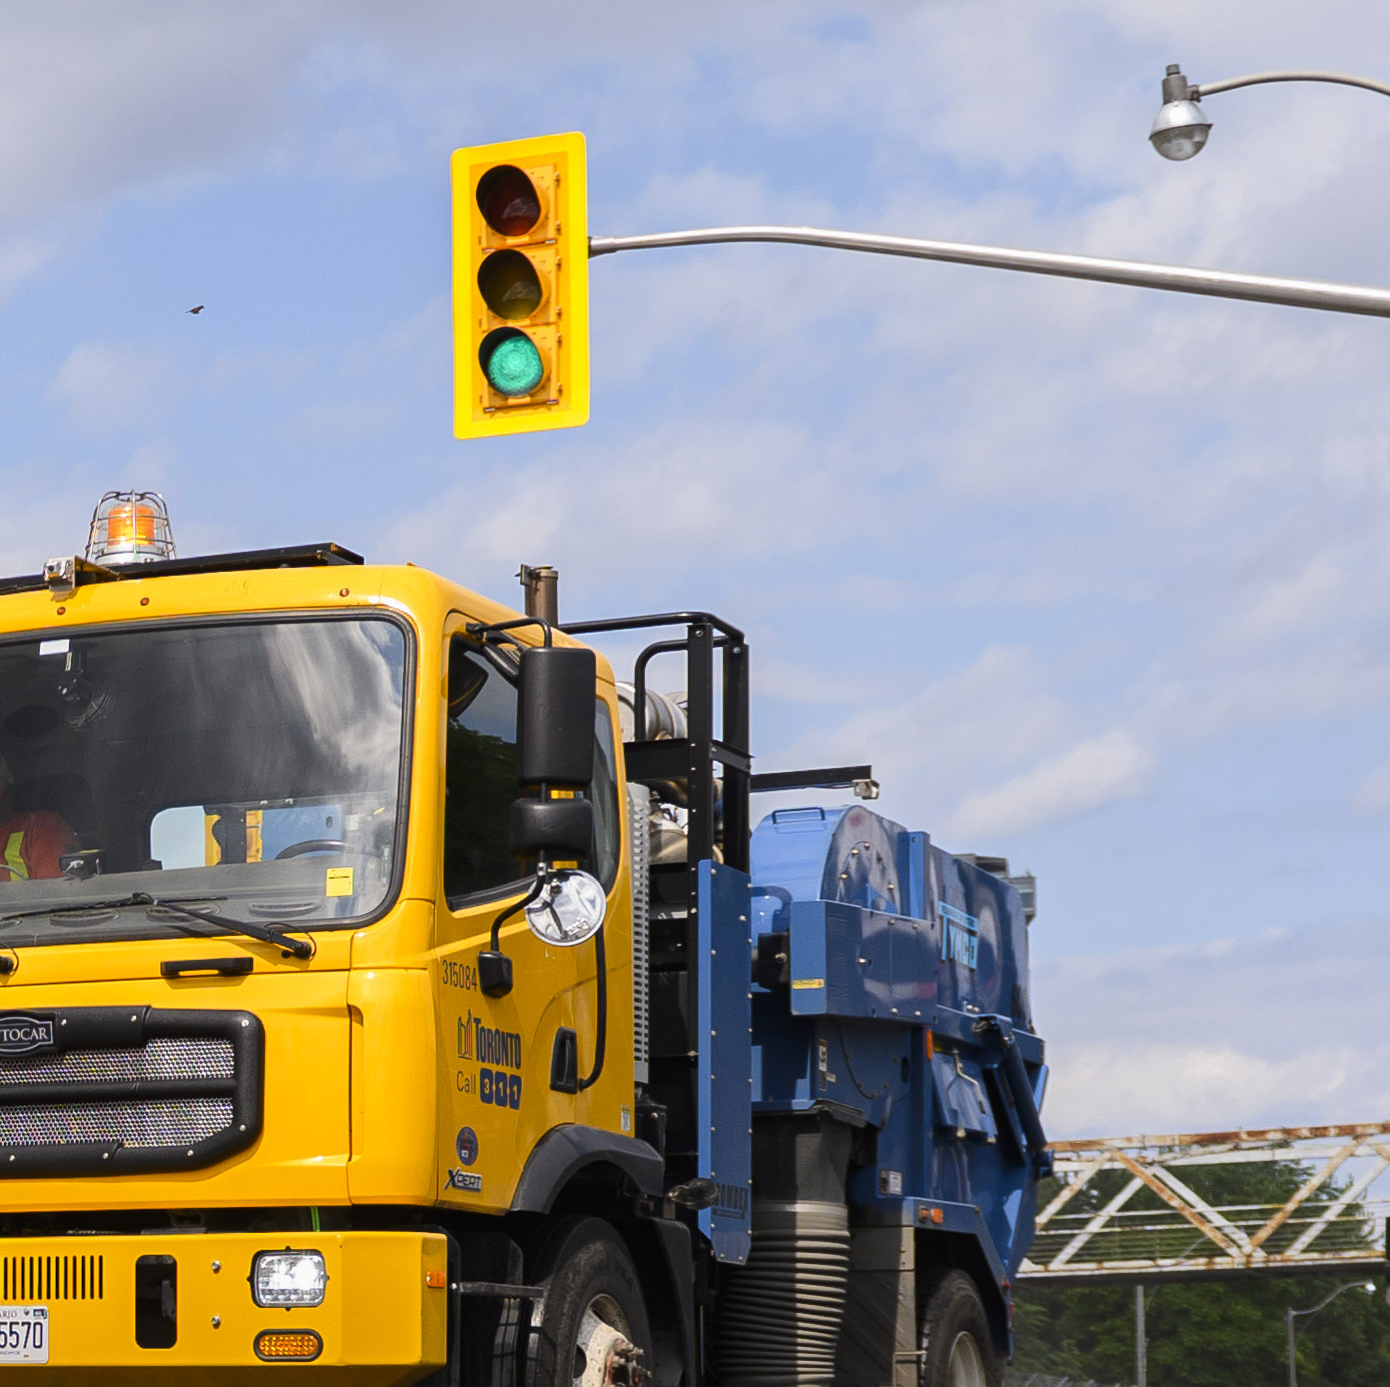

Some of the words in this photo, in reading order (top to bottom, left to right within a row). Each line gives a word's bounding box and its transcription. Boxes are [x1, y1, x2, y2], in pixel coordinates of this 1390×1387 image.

[443, 959, 477, 992] 315084
[473, 1017, 521, 1070] TORONTO
[456, 1070, 477, 1095] Call
